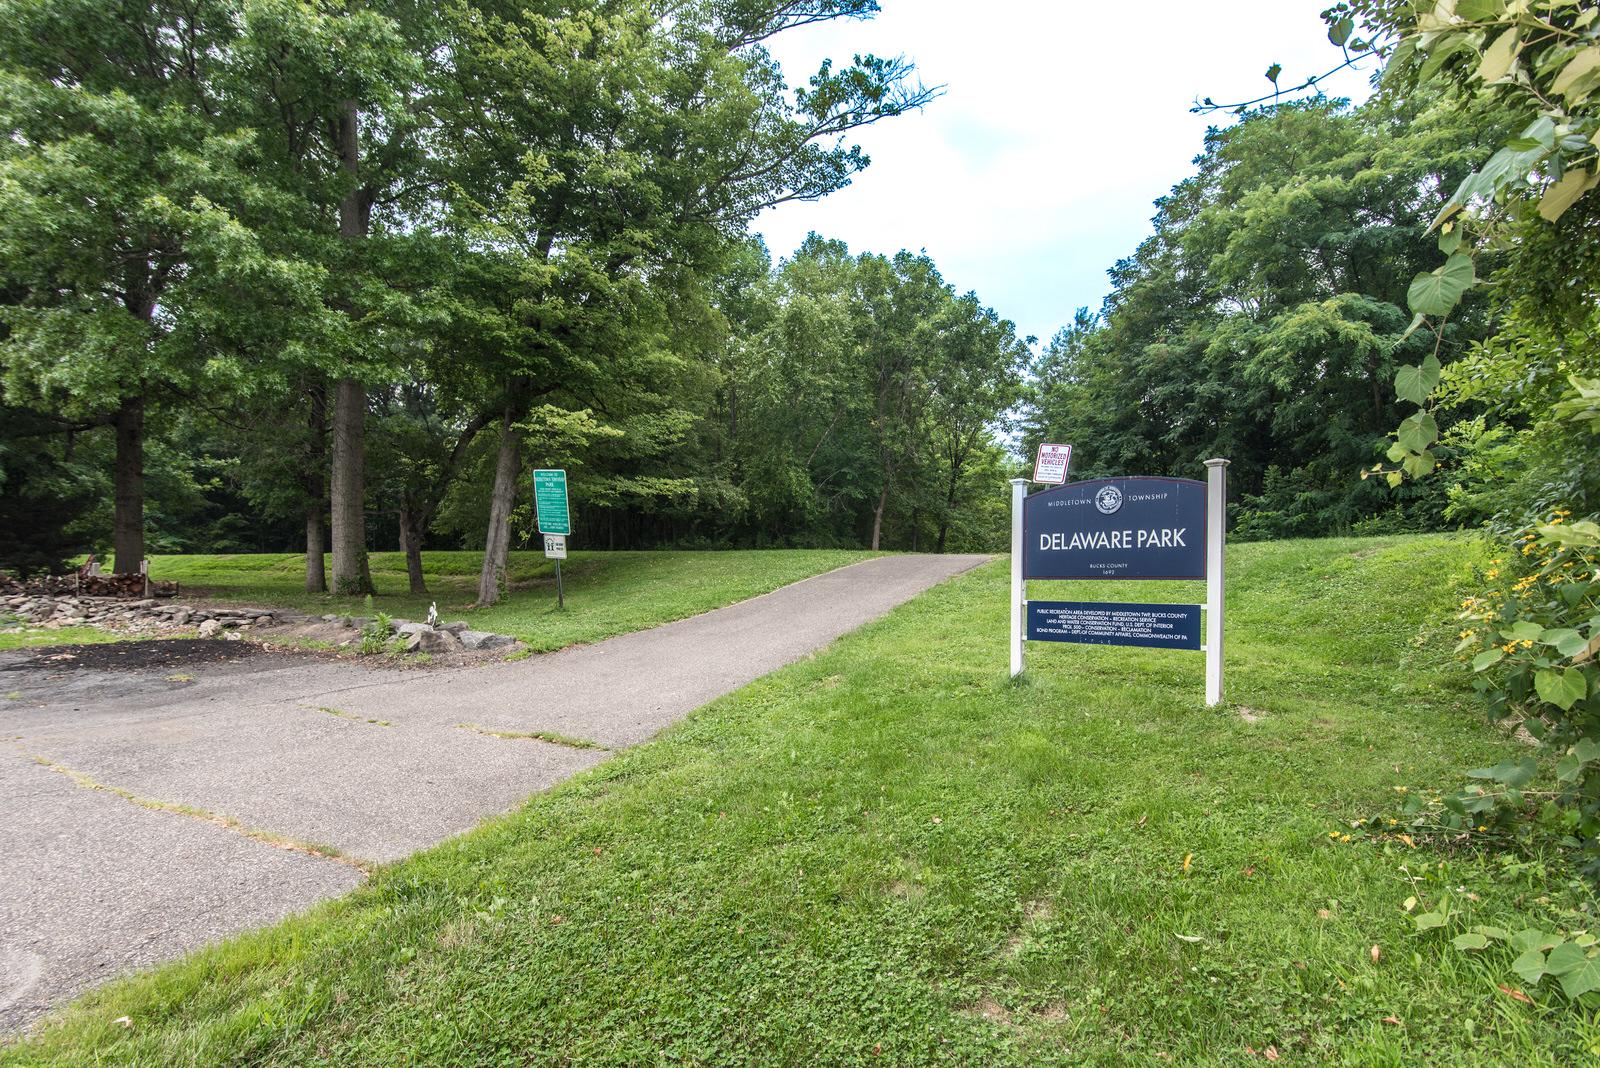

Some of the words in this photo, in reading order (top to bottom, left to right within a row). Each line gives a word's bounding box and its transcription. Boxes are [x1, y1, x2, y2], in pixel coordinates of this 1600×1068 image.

[1128, 493, 1168, 501] TOWNSHIP
[1040, 530, 1132, 550] DELAWARE
[1137, 528, 1186, 548] PARK
